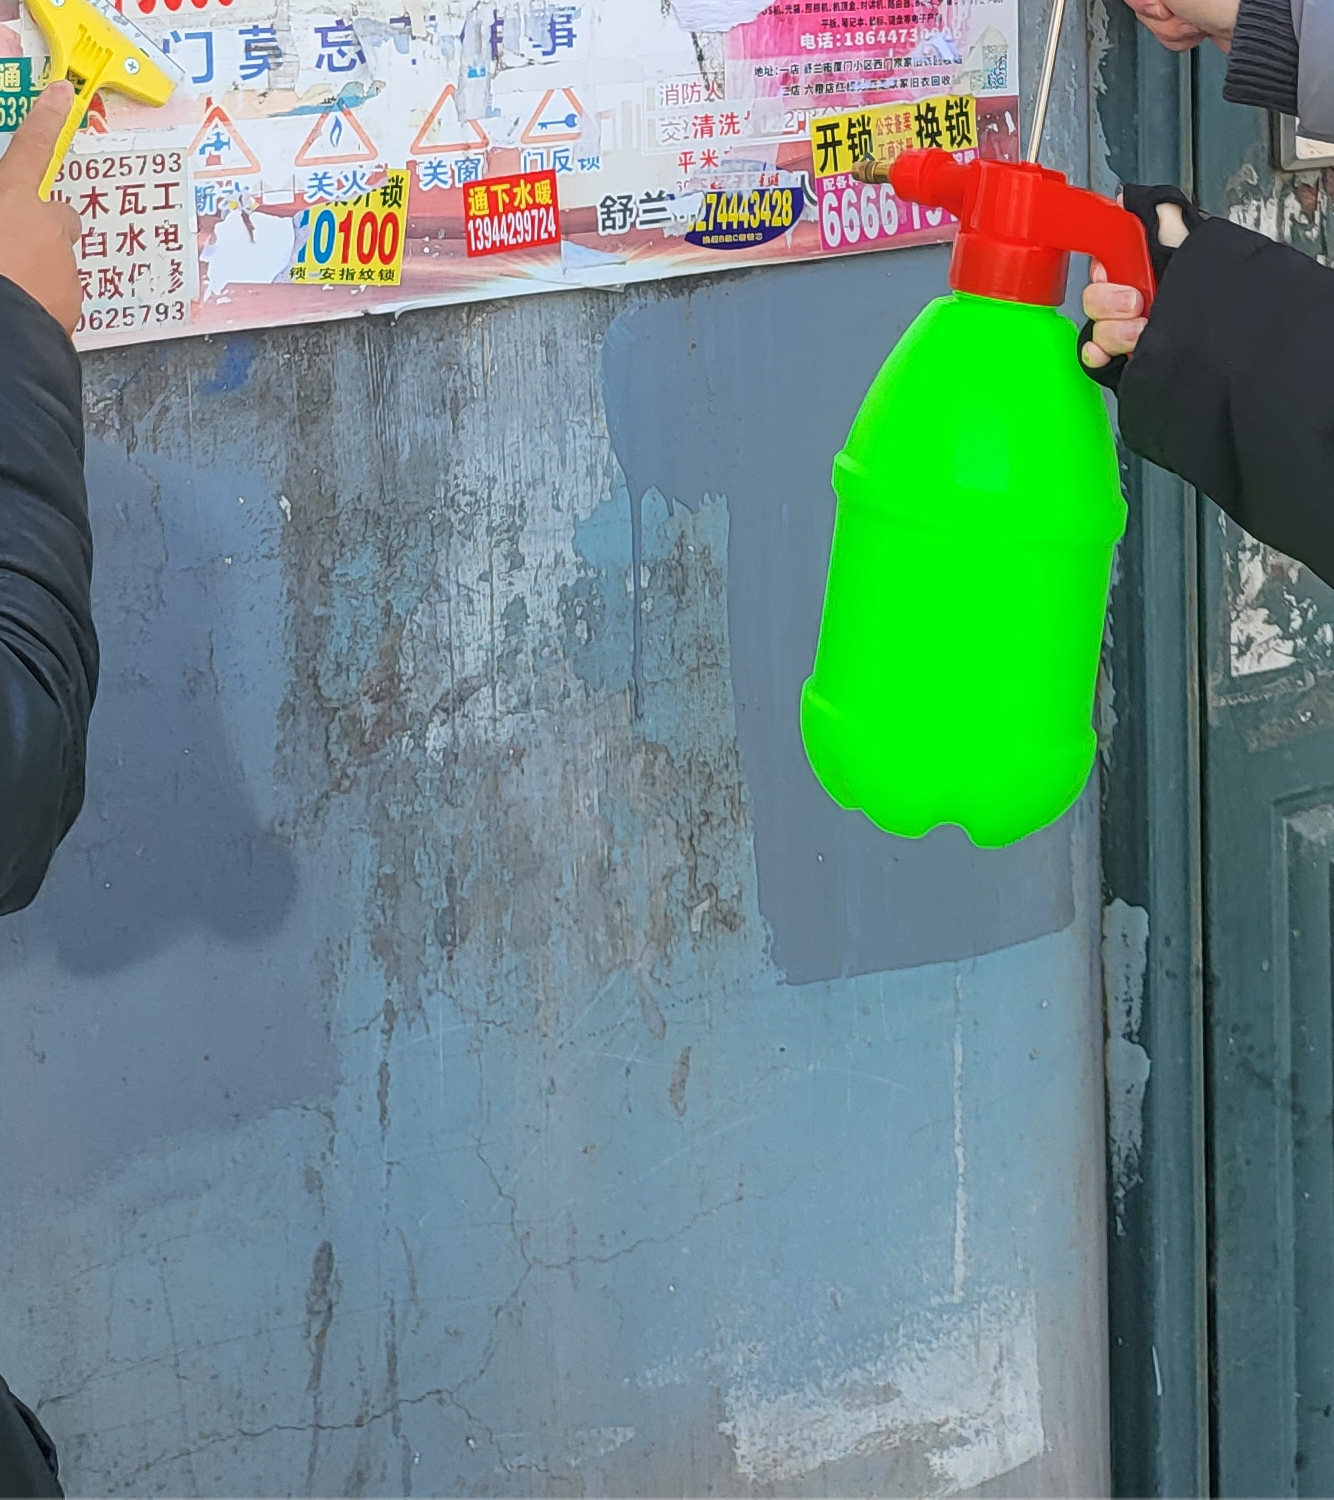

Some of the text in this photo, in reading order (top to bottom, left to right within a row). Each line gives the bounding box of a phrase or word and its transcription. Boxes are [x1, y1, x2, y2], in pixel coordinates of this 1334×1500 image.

[163, 3, 582, 85] 门莫忘事
[691, 111, 742, 140] 清洗
[815, 114, 876, 174] 开锁
[875, 110, 913, 138] 公安备案
[914, 96, 974, 150] 换锁
[306, 170, 368, 199] 关火
[420, 157, 482, 190] 关窗
[677, 148, 720, 175] 平米
[468, 179, 554, 217] 通下水暖
[467, 205, 557, 253] 13944299724
